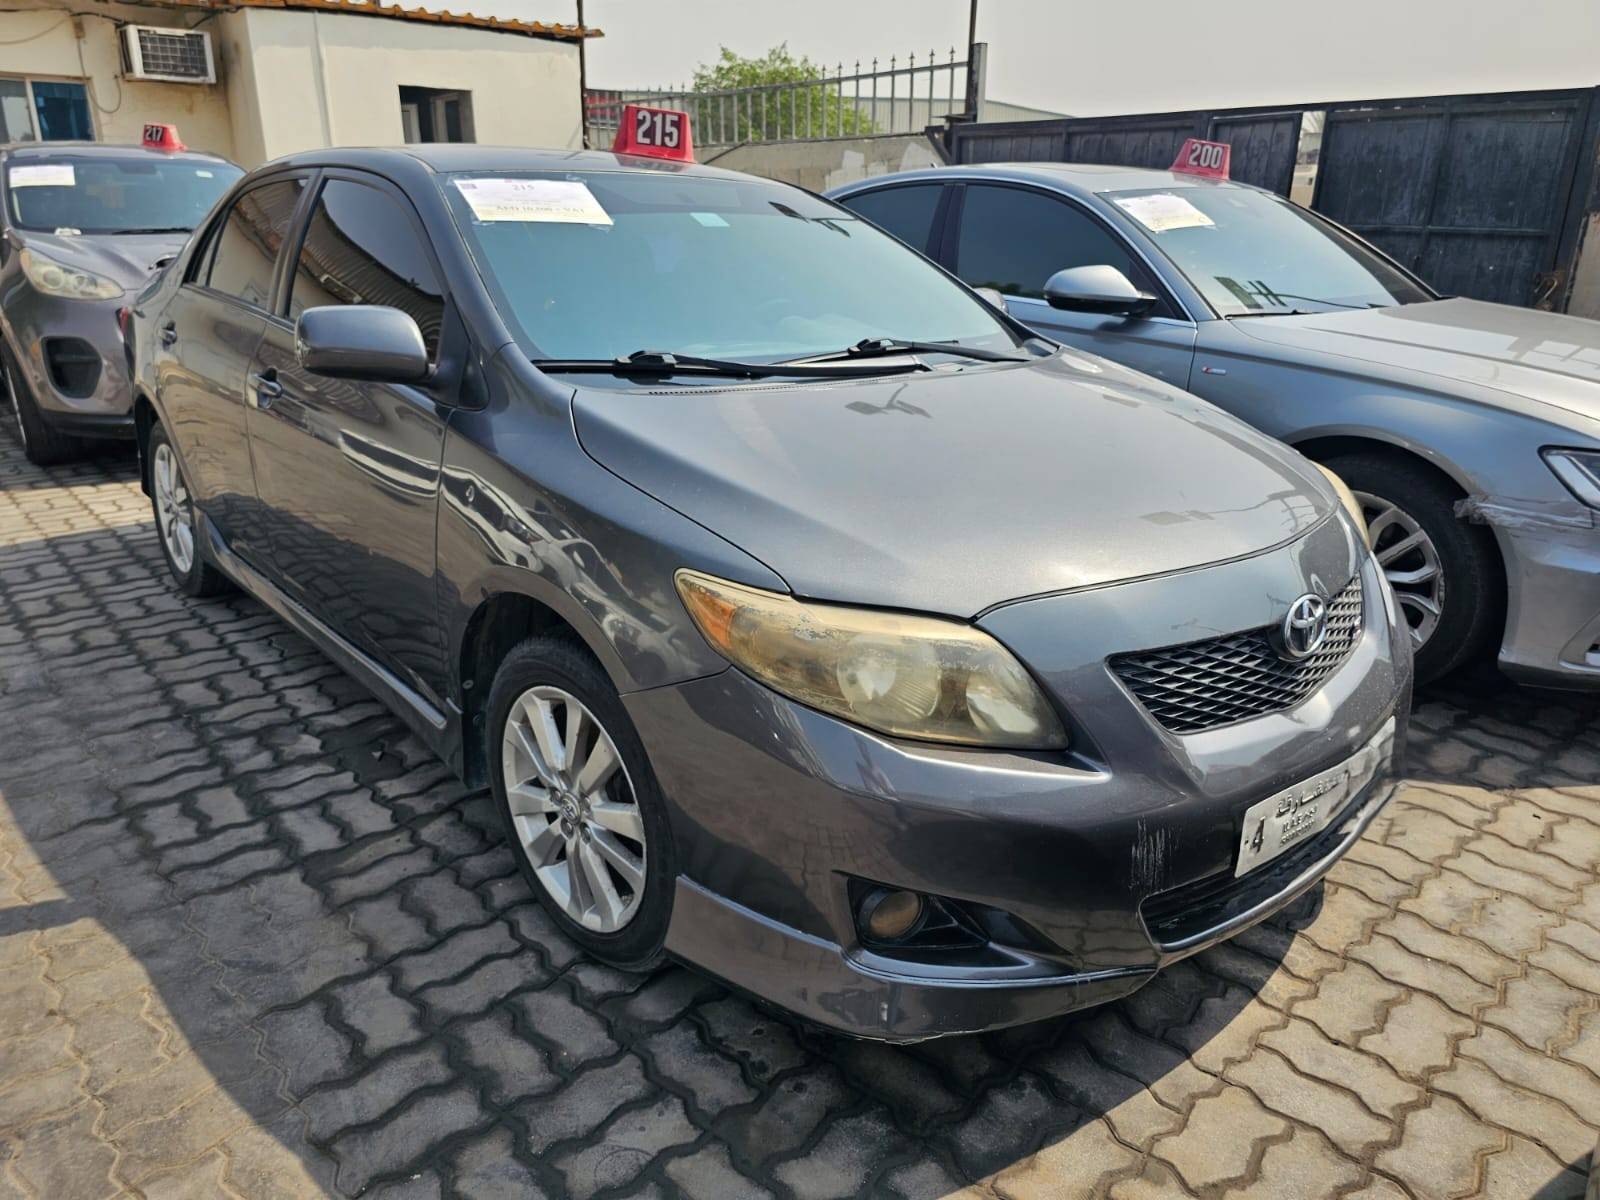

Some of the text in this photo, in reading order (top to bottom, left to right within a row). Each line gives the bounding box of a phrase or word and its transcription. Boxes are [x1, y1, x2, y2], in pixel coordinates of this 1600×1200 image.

[145, 126, 163, 142] 217
[636, 110, 679, 148] 215
[1188, 143, 1223, 169] 200
